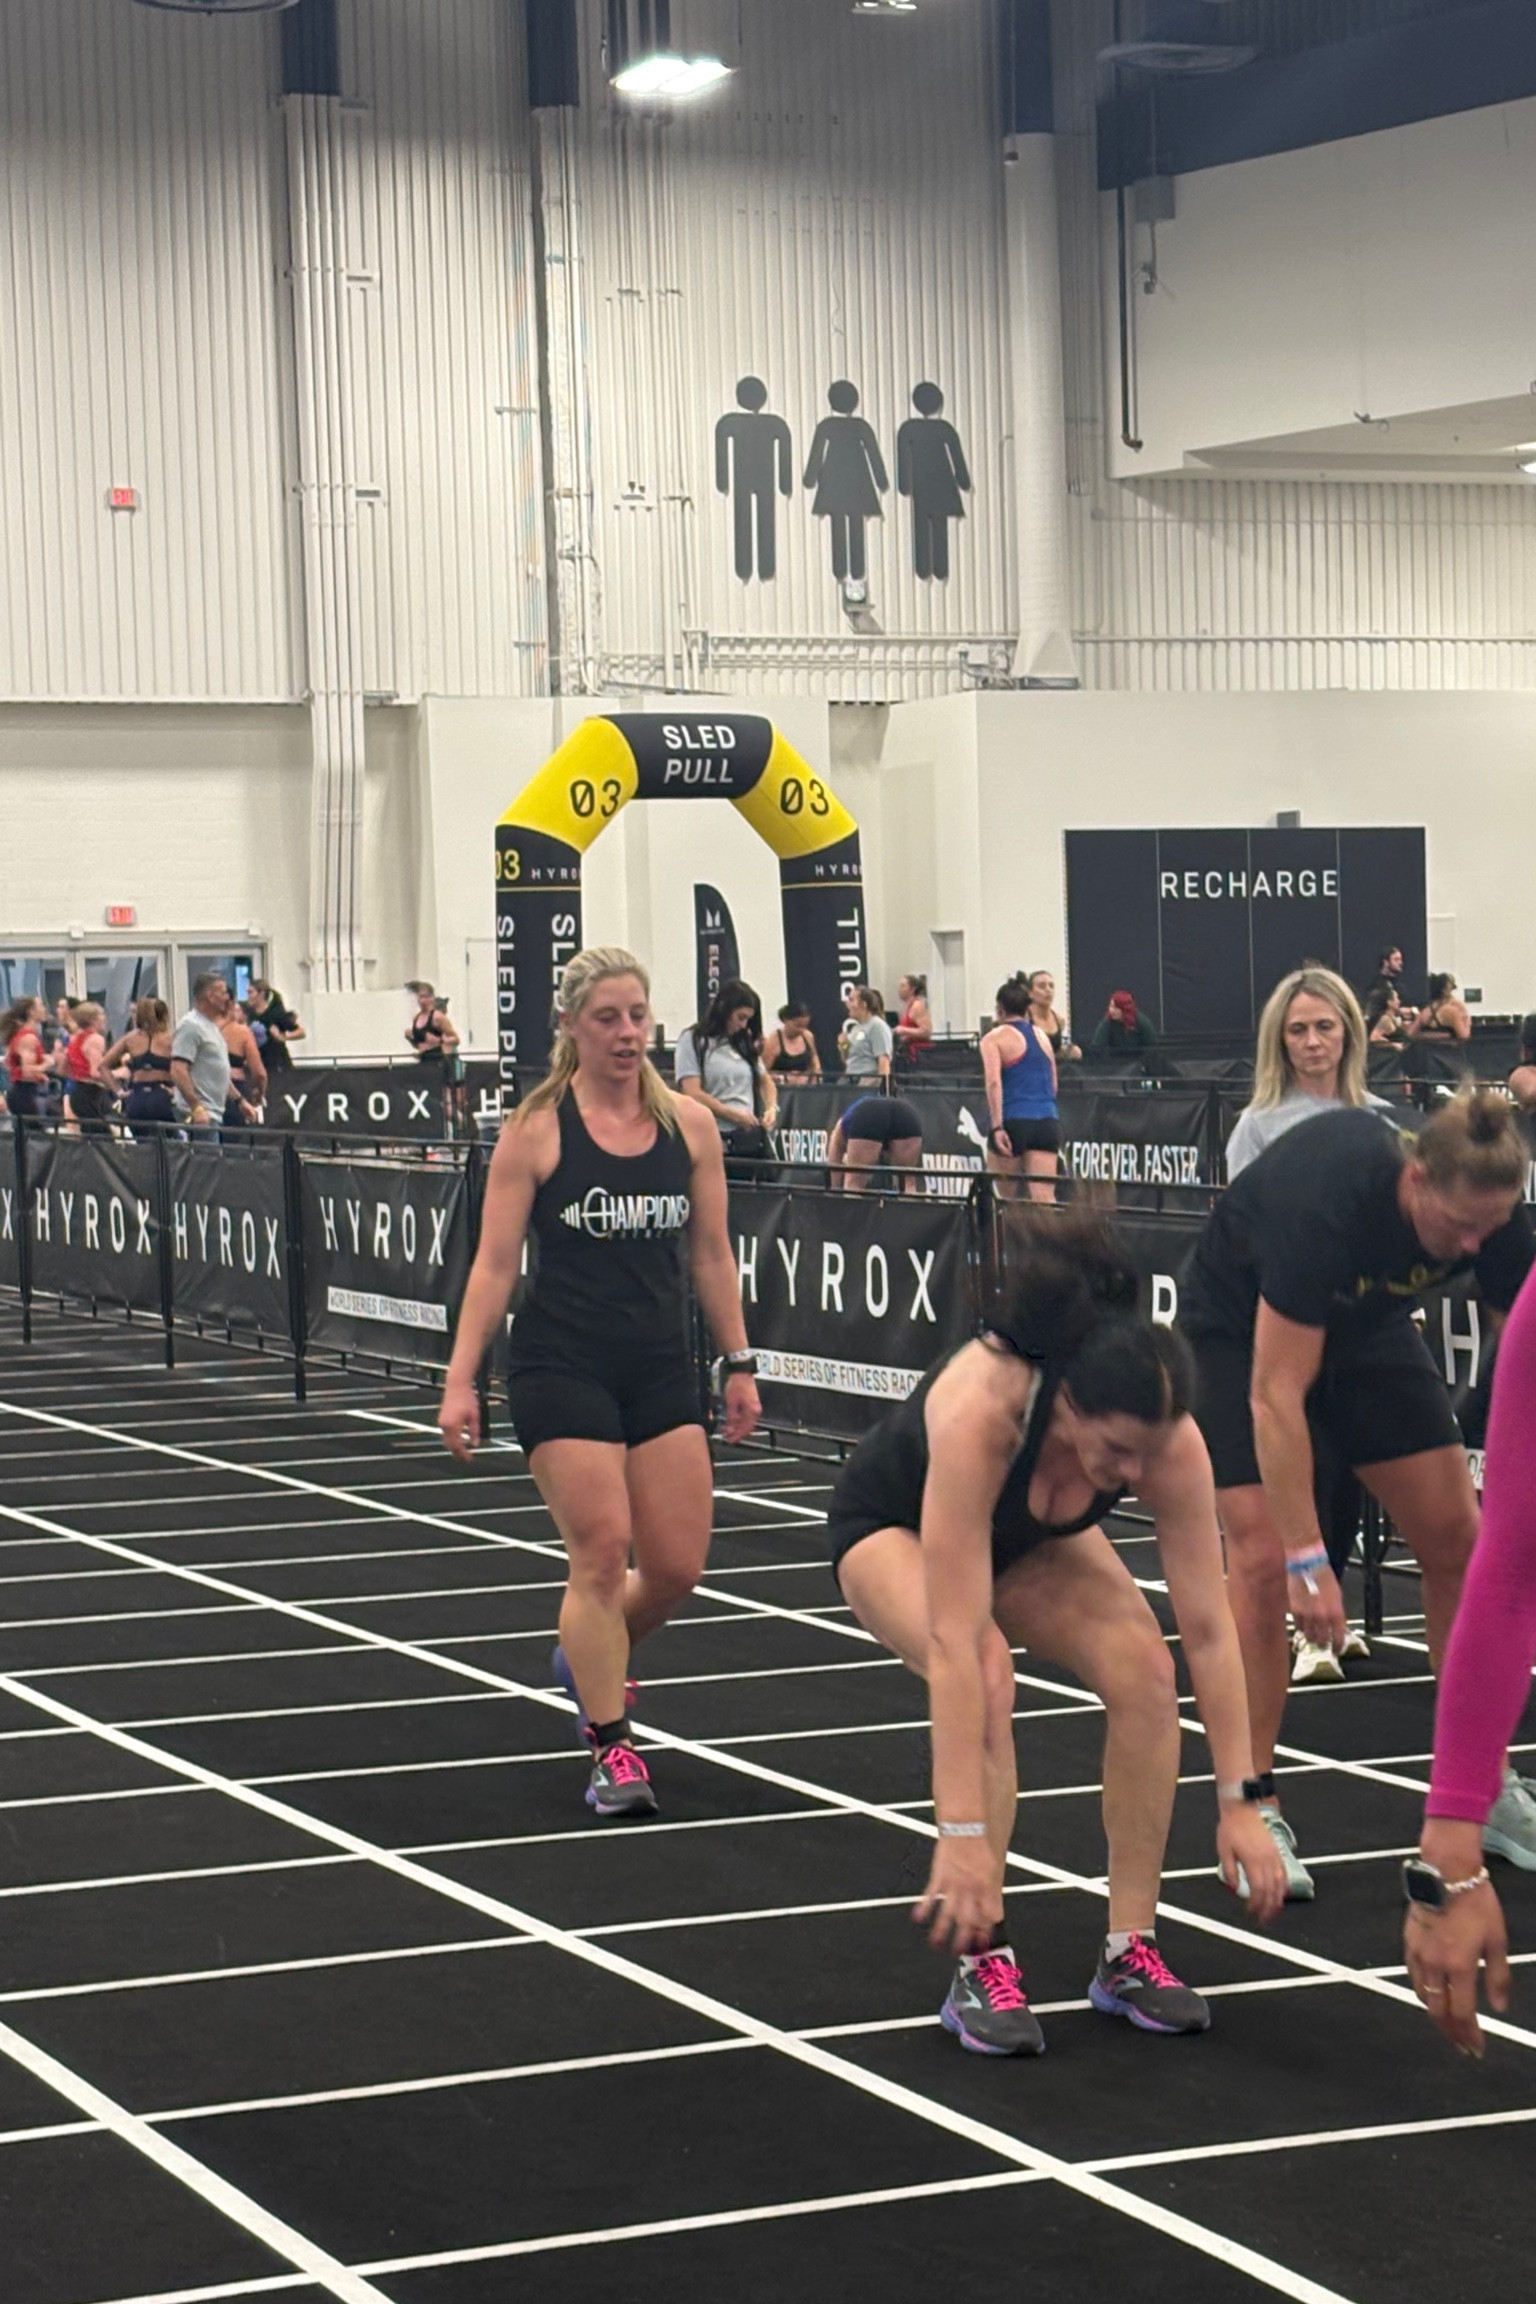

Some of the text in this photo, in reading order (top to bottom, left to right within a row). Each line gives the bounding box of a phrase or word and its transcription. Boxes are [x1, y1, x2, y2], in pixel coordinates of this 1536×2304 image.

[662, 725, 737, 750] SLED
[663, 758, 734, 784] PULL
[570, 779, 622, 818] 03
[780, 778, 830, 816] 03
[531, 867, 582, 880] HYRO
[814, 863, 862, 877] HYRO
[1160, 870, 1338, 899] RECHARGE
[497, 914, 516, 1014] SLED
[257, 1089, 431, 1123] YROX
[1072, 1141, 1201, 1185] FOREVER. FASTER.
[36, 1187, 152, 1255] HYROX
[319, 1196, 445, 1267] HYROX
[174, 1201, 281, 1280] HYROX
[737, 1234, 937, 1323] HYROX
[783, 1356, 824, 1383] SERIES
[824, 1362, 837, 1386] OF
[839, 1365, 889, 1394] FITNESS
